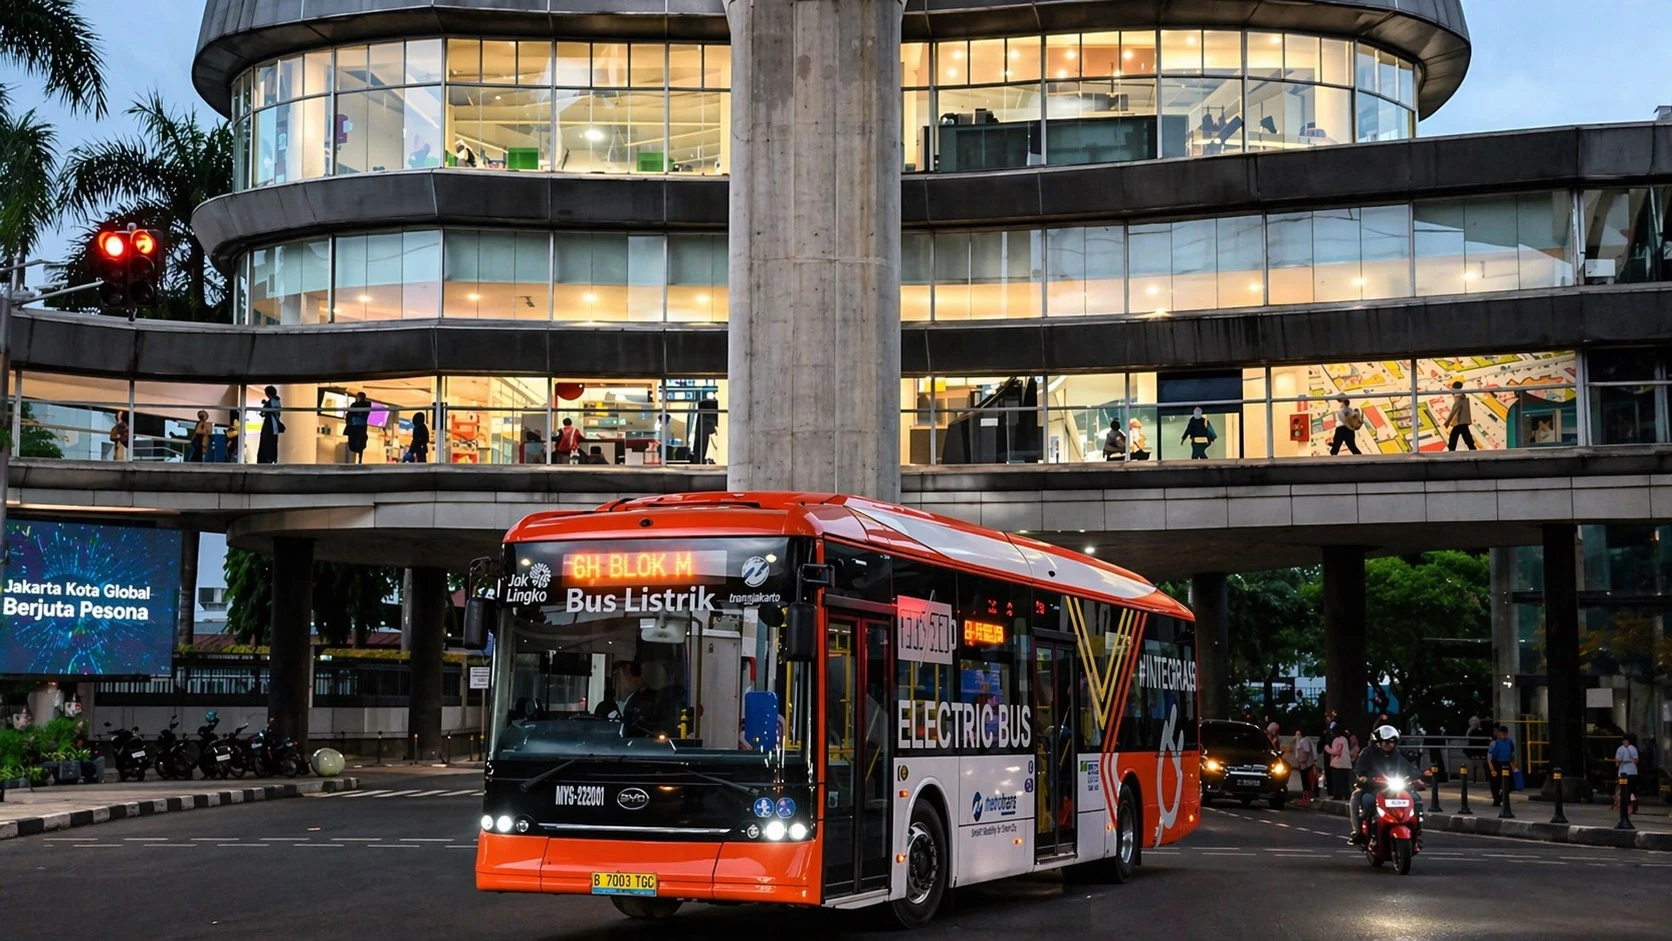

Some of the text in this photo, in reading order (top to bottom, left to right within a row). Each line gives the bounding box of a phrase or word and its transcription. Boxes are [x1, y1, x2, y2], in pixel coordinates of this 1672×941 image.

[573, 551, 692, 578] 6H BLOK M
[4, 579, 151, 600] Jakarta Kota Global
[506, 588, 547, 605] Lingko
[566, 585, 716, 613] Bus Listrik
[3, 597, 149, 621] Berjuta Pesona
[898, 700, 1031, 749] ELECTRIC BUS
[620, 793, 645, 803] BYD
[594, 874, 655, 888] B 7003 TGC
